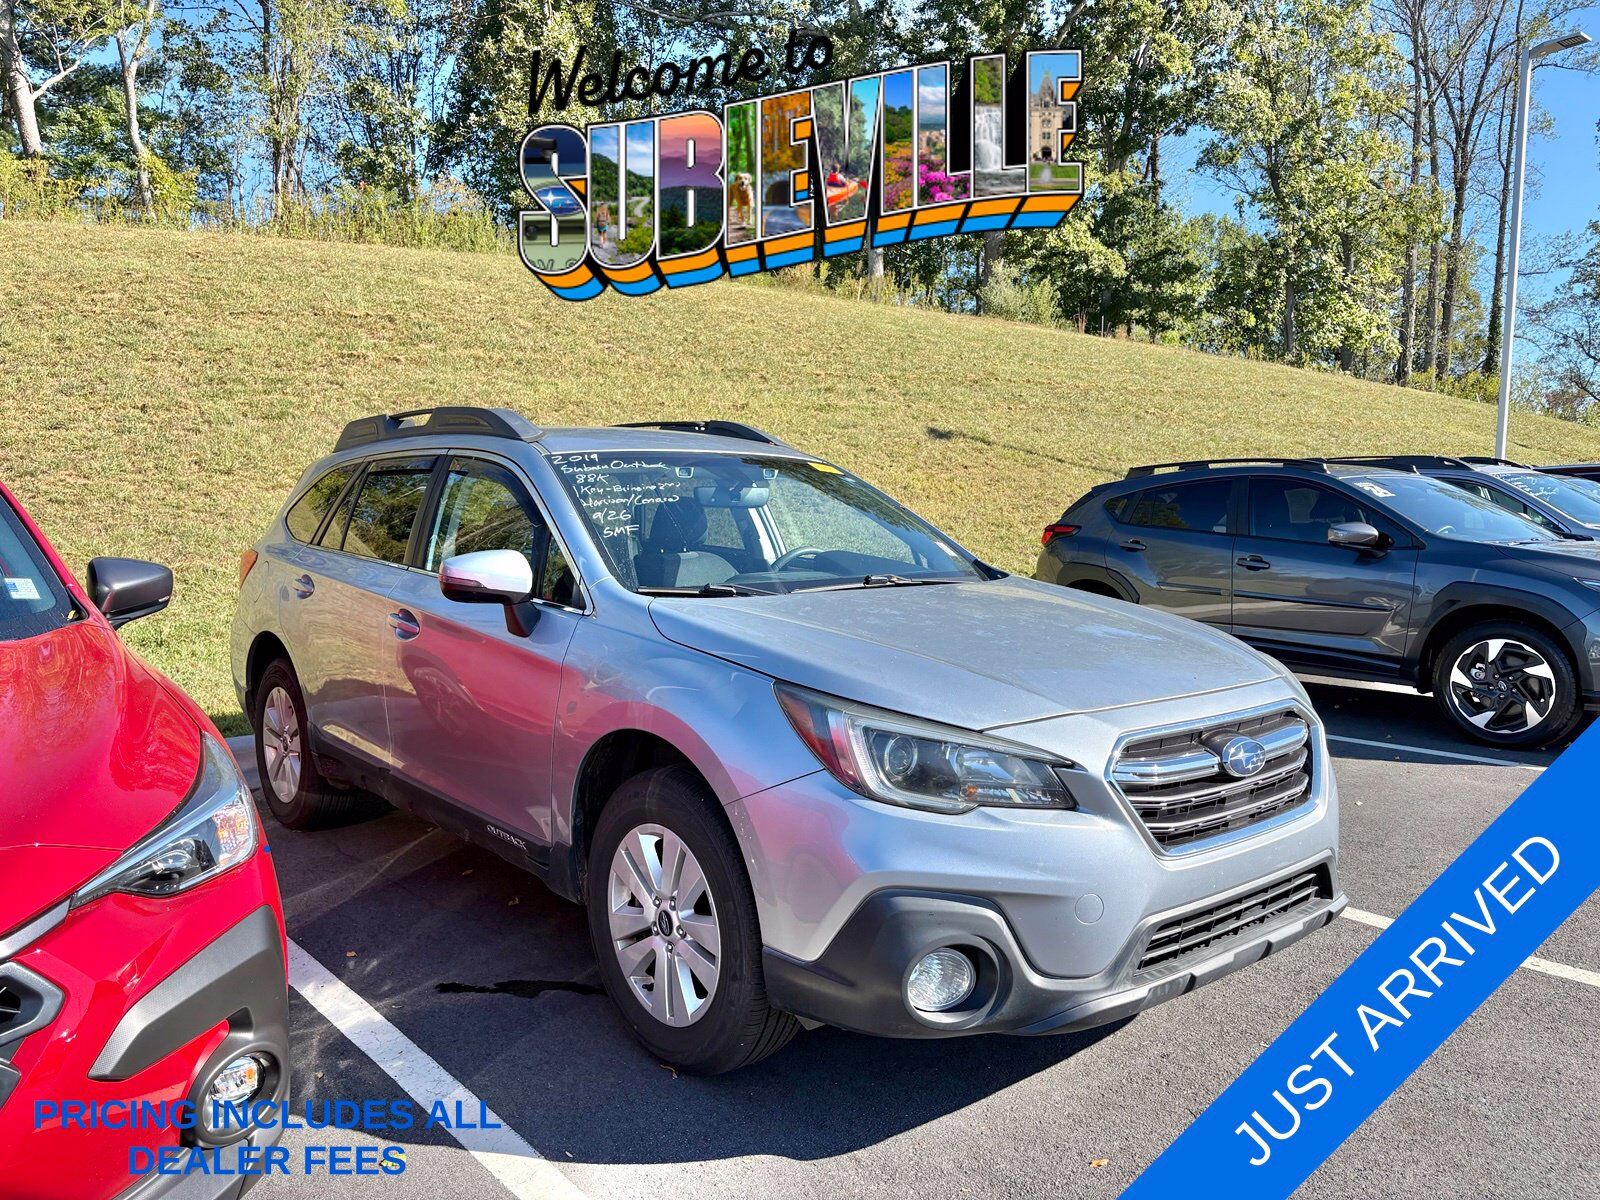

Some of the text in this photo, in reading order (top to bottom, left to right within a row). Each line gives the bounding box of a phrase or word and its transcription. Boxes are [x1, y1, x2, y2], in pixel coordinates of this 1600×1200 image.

[551, 454, 599, 464] 2019
[576, 473, 609, 484] 88K
[592, 508, 632, 522] 9/26
[603, 524, 640, 538] SMF
